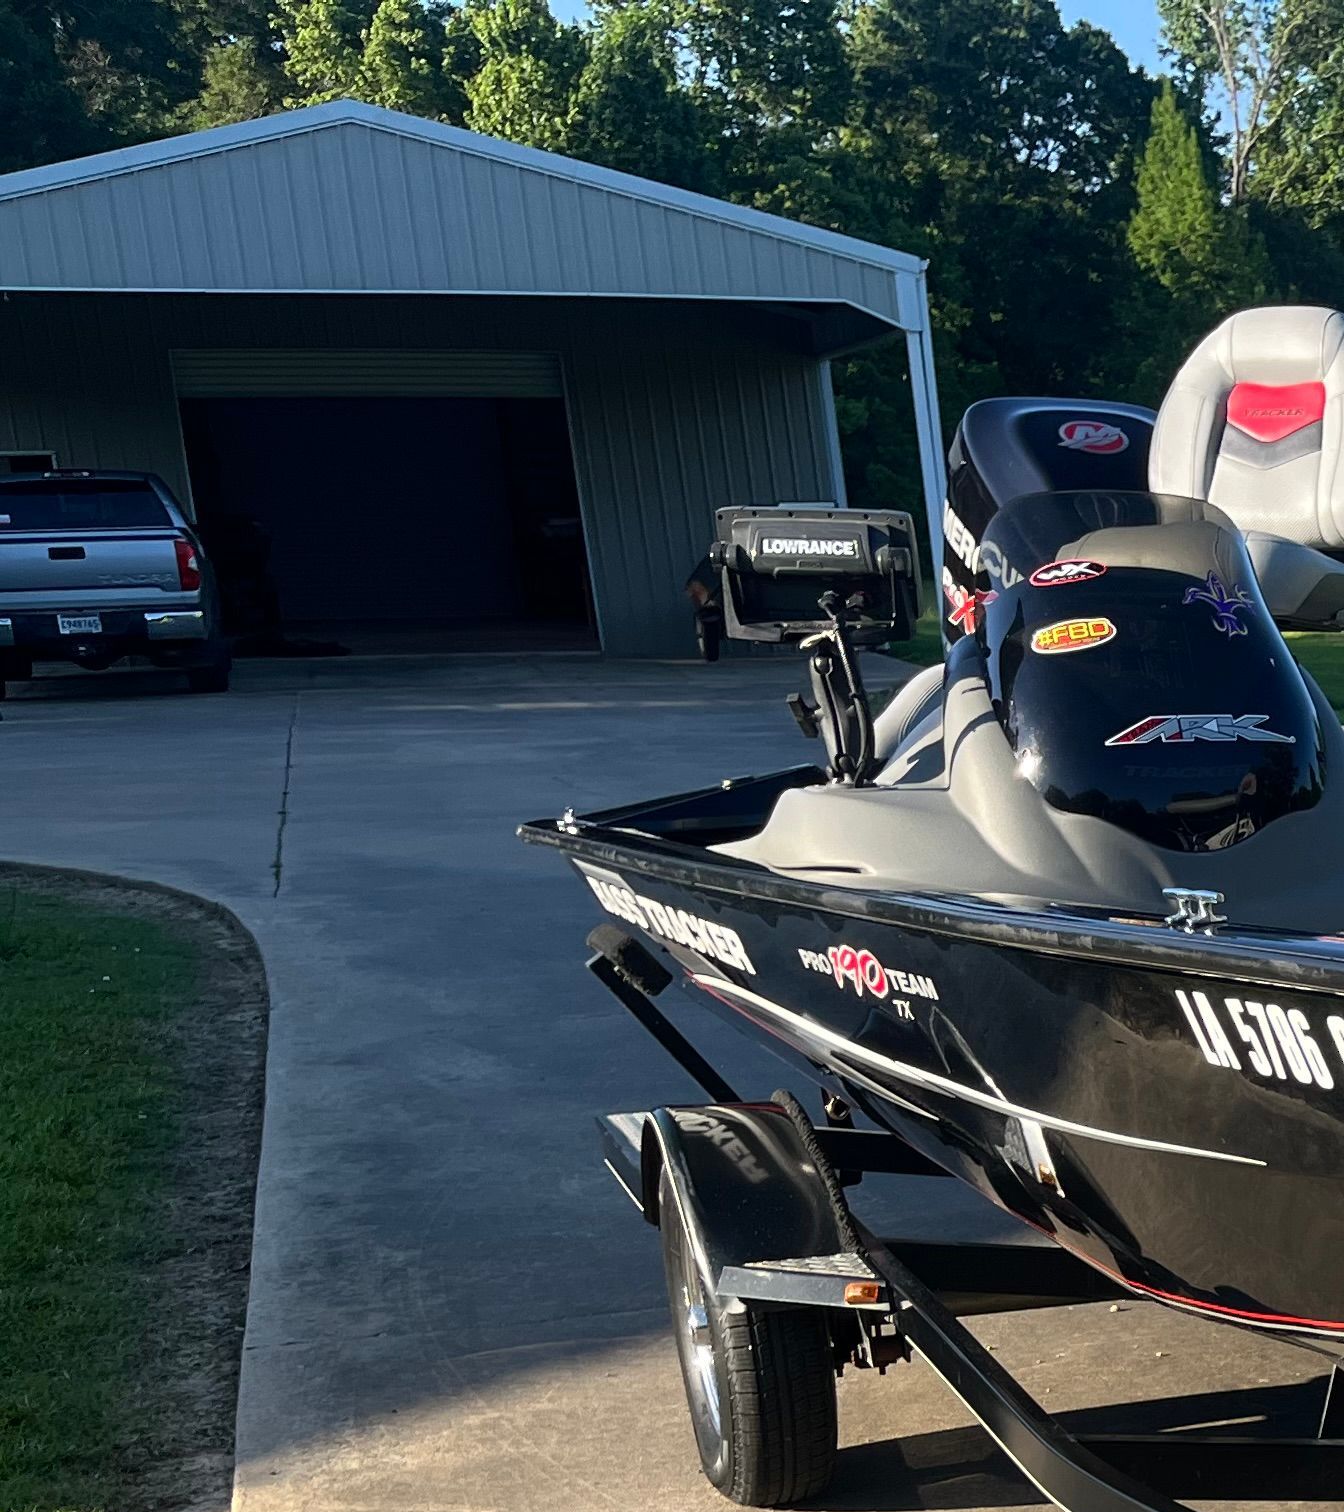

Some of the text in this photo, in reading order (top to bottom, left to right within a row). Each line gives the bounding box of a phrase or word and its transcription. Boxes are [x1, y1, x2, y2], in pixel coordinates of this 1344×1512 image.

[762, 538, 855, 556] LOWRANCE
[635, 895, 757, 975] TRACKER
[798, 948, 833, 975] PRO
[884, 968, 939, 1000] TEAM
[892, 1000, 915, 1020] TX
[1175, 990, 1241, 1070] LA
[1224, 998, 1334, 1090] 5786
